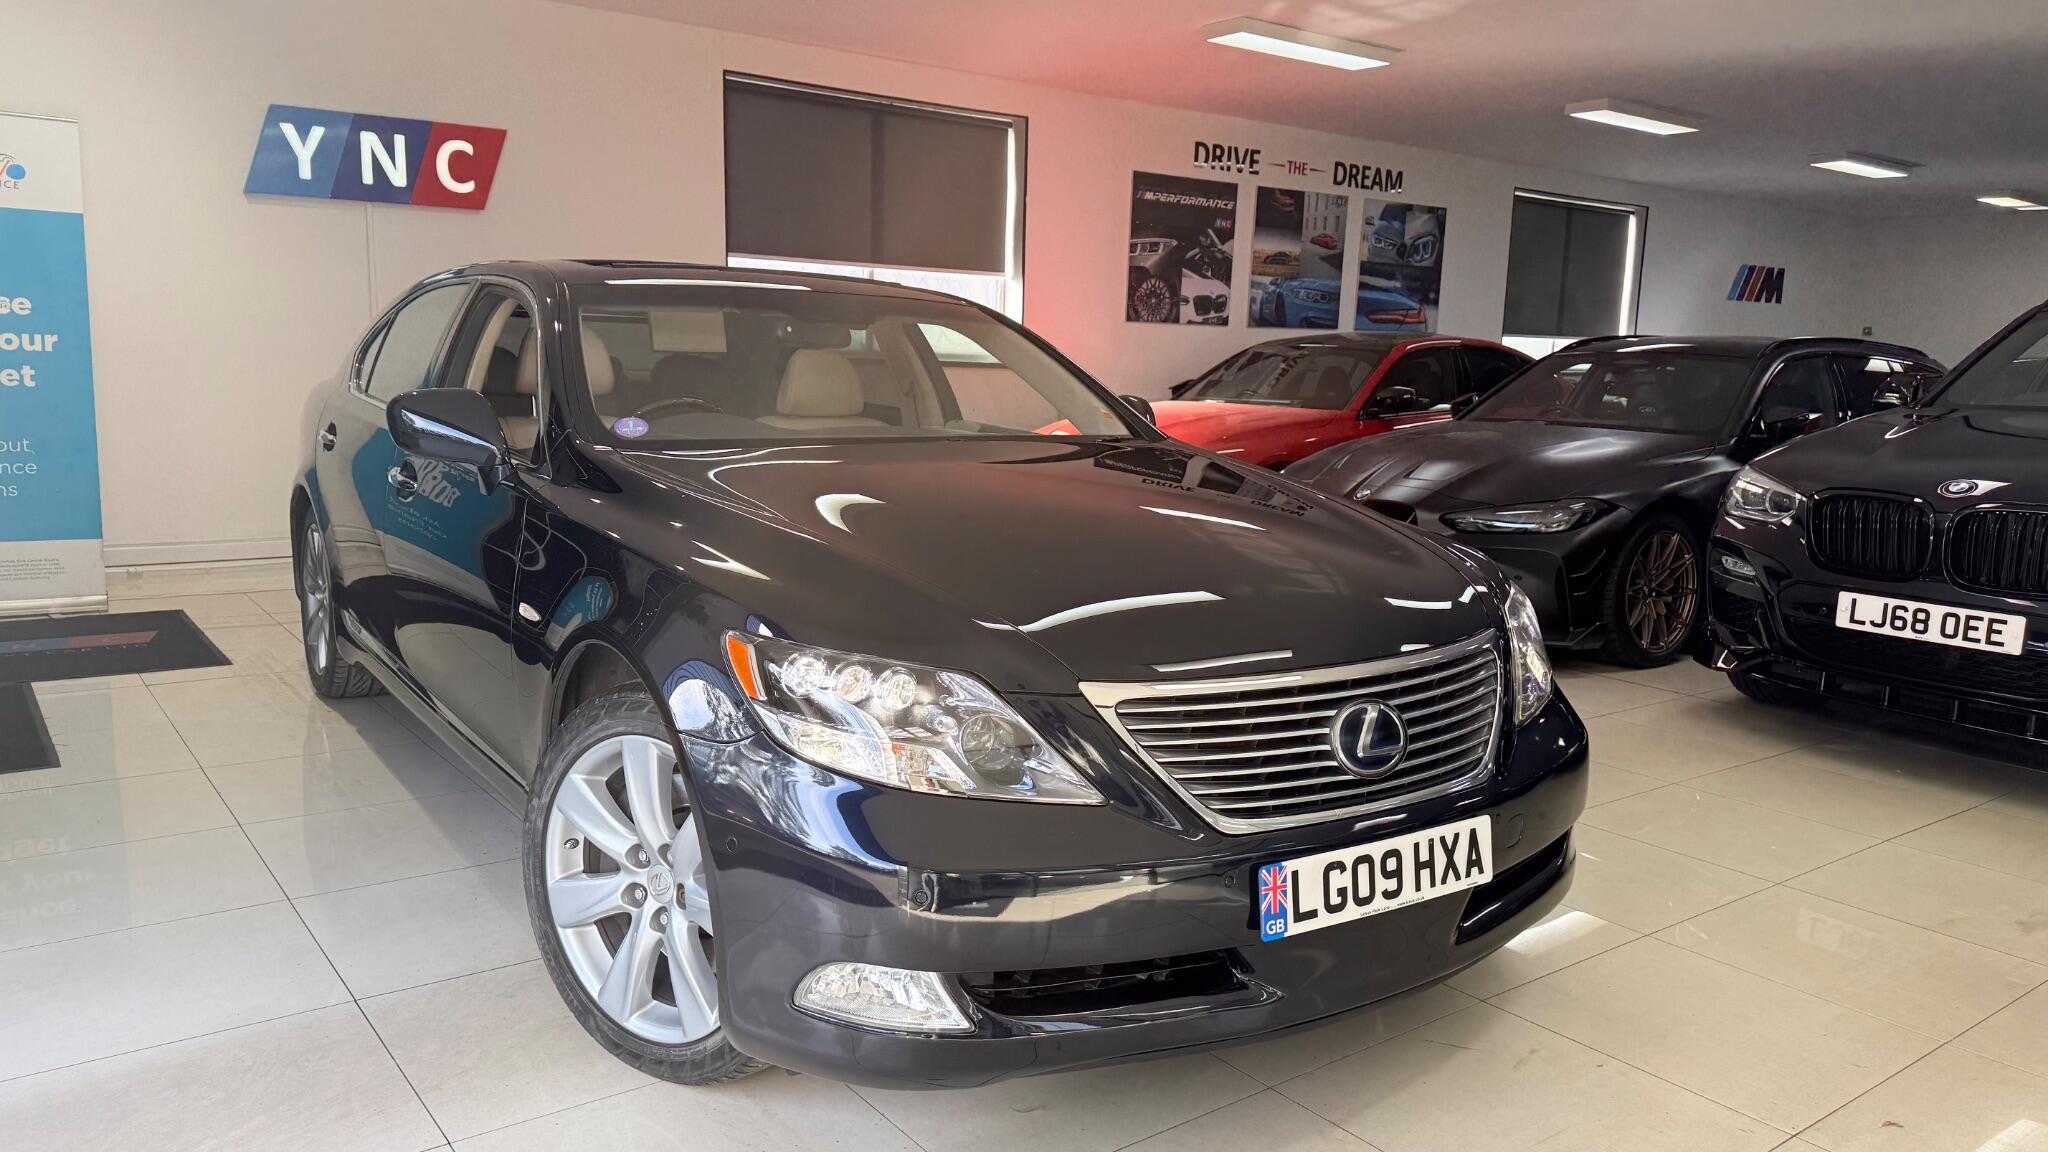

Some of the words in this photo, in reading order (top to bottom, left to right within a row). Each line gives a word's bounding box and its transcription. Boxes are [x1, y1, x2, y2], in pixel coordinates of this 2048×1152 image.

[279, 122, 476, 194] YNC
[1193, 141, 1261, 175] DRIVE
[1287, 160, 1309, 176] THE
[1333, 160, 1404, 194] DREAM
[1849, 597, 1931, 636] LJ68
[1940, 611, 2008, 648] OEE
[1290, 848, 1404, 924] LG09
[1413, 827, 1485, 893] HXA
[1265, 918, 1285, 935] GB
